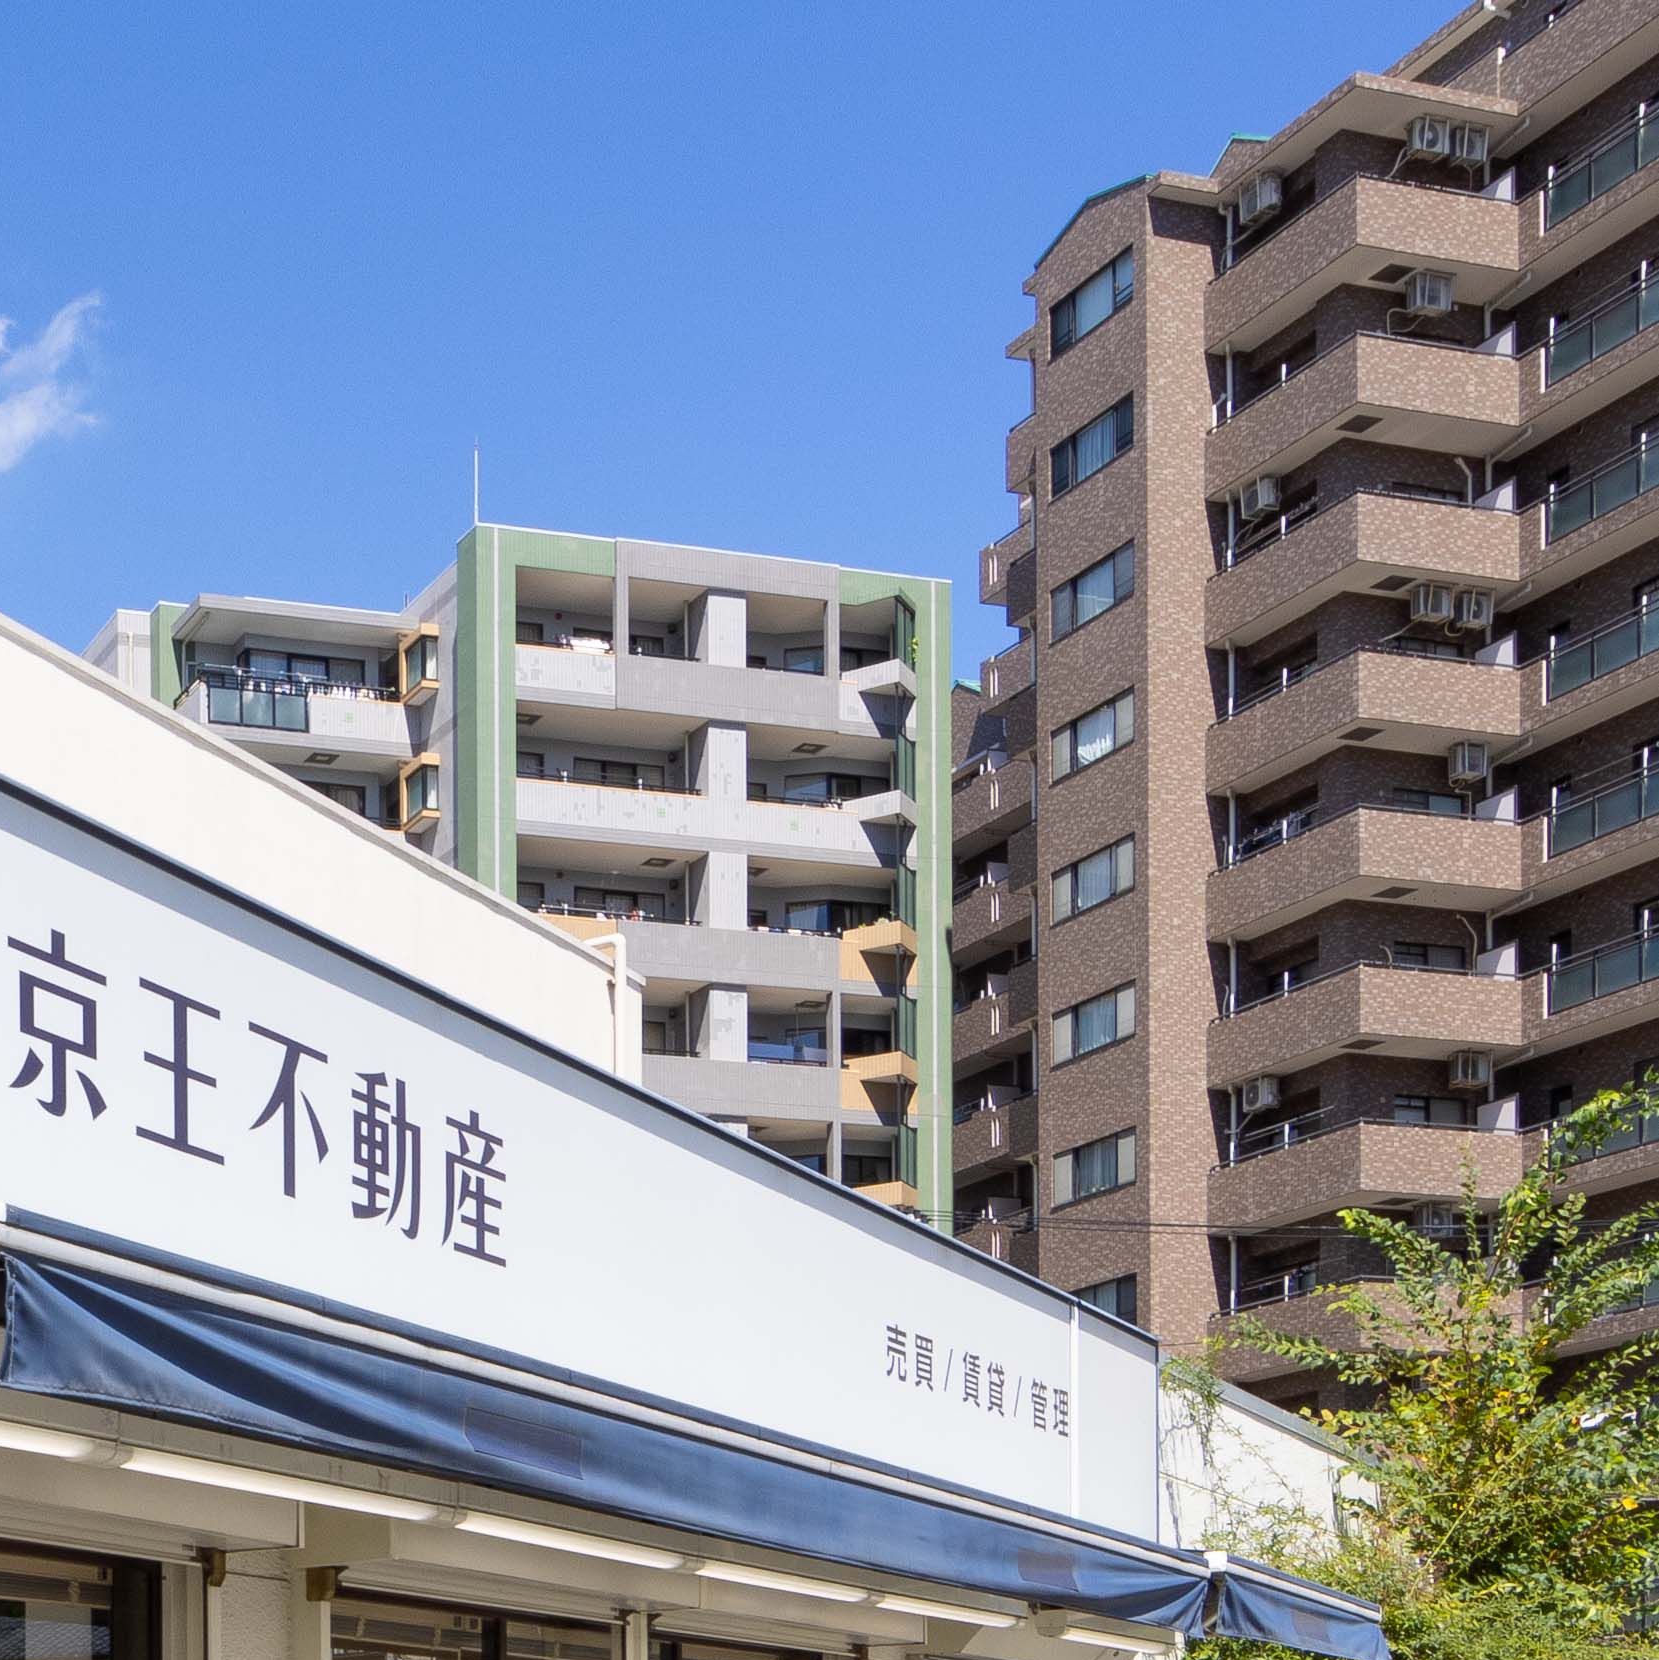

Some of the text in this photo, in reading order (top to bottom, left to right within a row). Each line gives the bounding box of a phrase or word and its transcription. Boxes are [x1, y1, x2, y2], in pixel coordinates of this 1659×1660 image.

[7, 928, 508, 1269] 京王不動産
